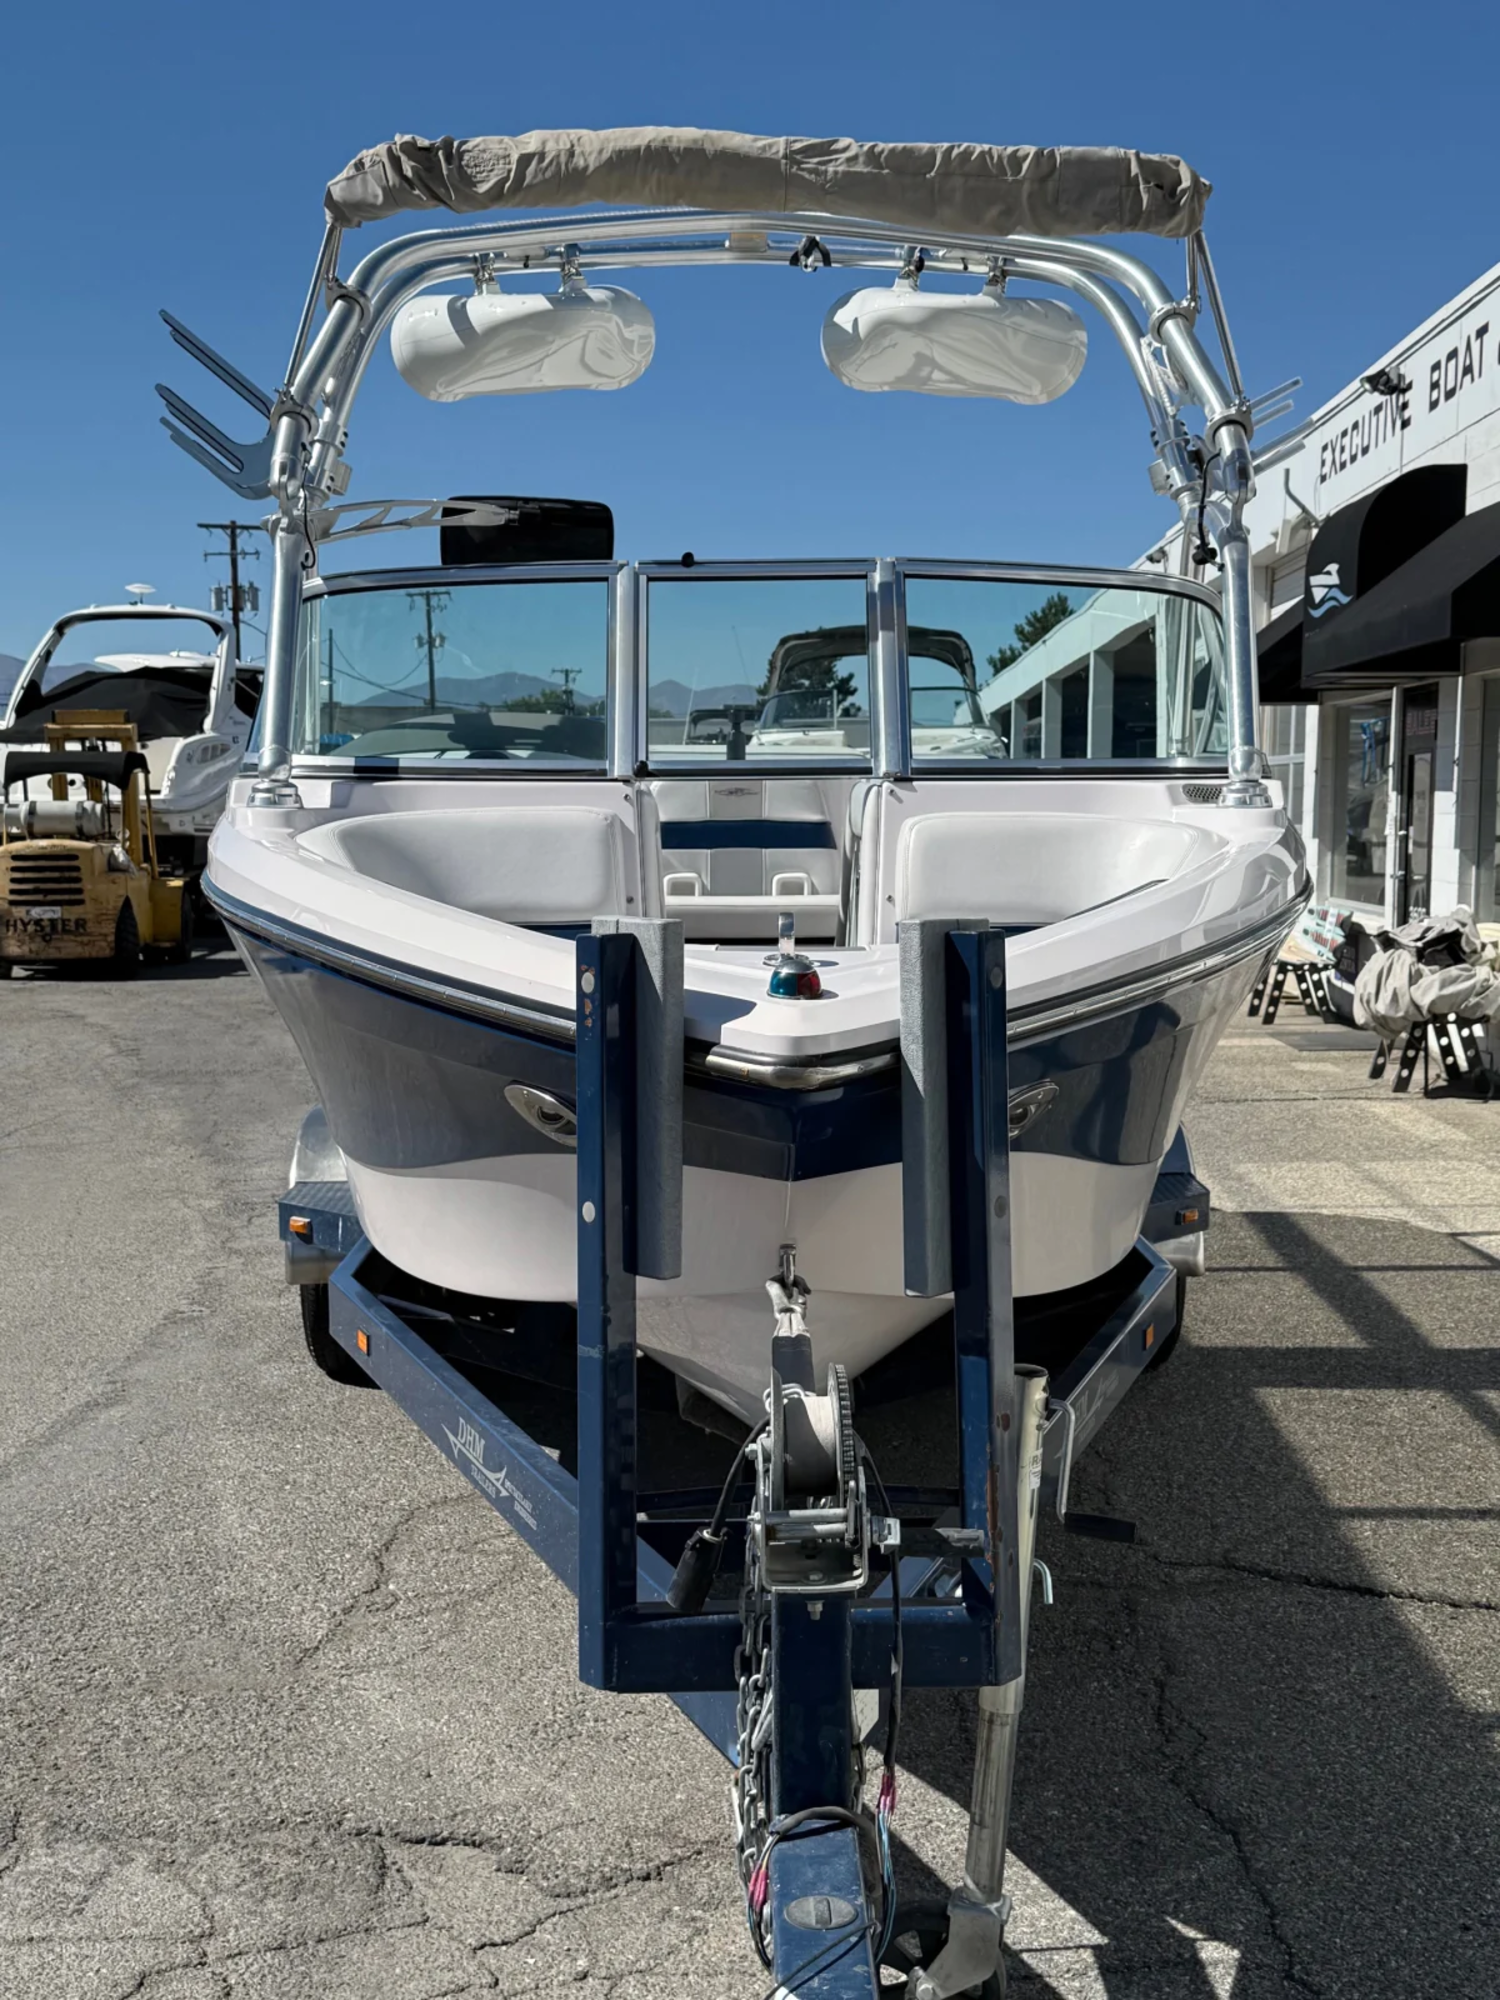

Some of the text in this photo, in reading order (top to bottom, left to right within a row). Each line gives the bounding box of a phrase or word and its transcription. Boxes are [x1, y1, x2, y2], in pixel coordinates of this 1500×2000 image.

[1320, 320, 1489, 485] EXECUTIVE BOAT
[5, 918, 87, 933] HYSTER
[458, 1416, 486, 1465] DHM
